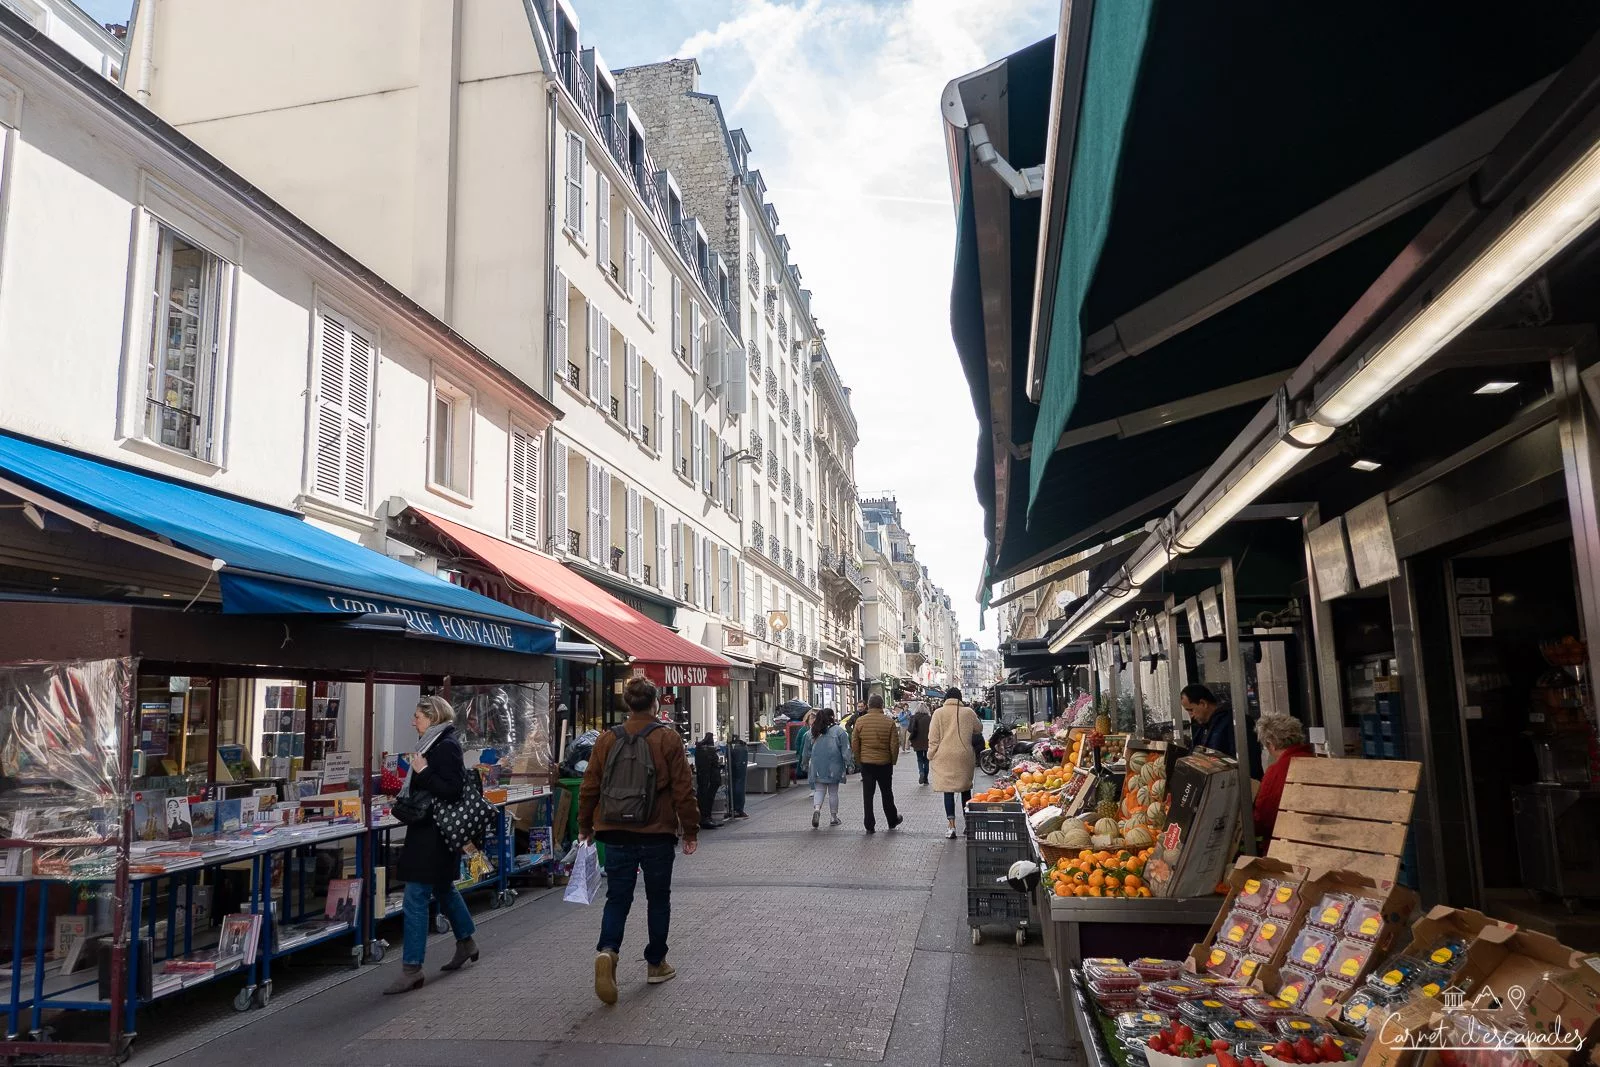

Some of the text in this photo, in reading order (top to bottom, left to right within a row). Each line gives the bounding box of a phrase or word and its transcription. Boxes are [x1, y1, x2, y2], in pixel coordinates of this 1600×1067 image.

[328, 596, 515, 649] LIBRIE FONTAINE
[664, 665, 708, 684] NON-STOP
[1180, 783, 1192, 808] MELON
